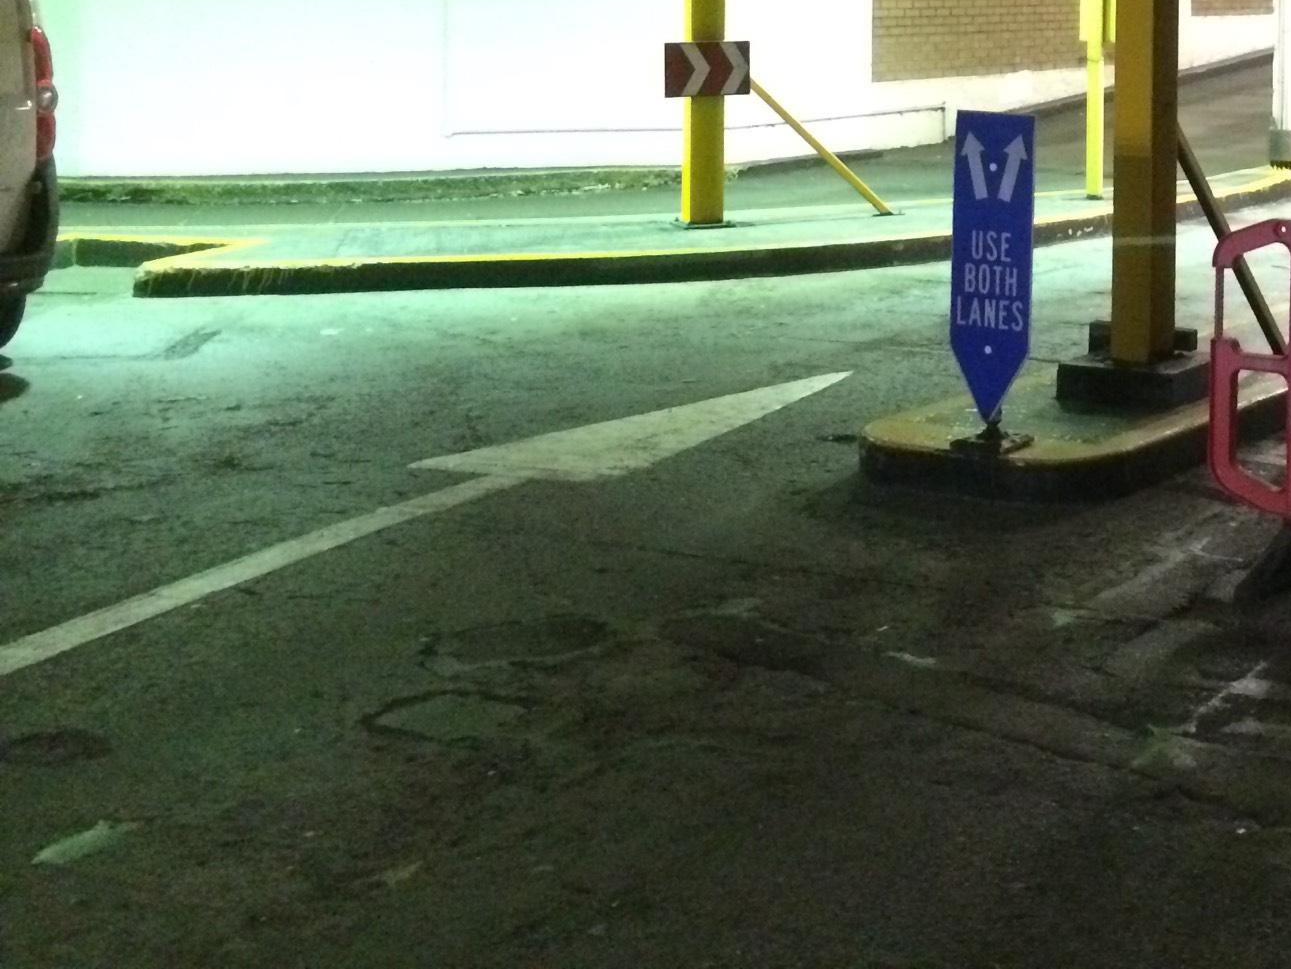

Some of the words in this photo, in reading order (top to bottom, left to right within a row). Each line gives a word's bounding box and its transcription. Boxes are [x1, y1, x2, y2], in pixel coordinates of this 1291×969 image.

[972, 230, 1012, 263] USE
[965, 263, 1018, 297] BOTH
[956, 296, 1023, 332] LANES
